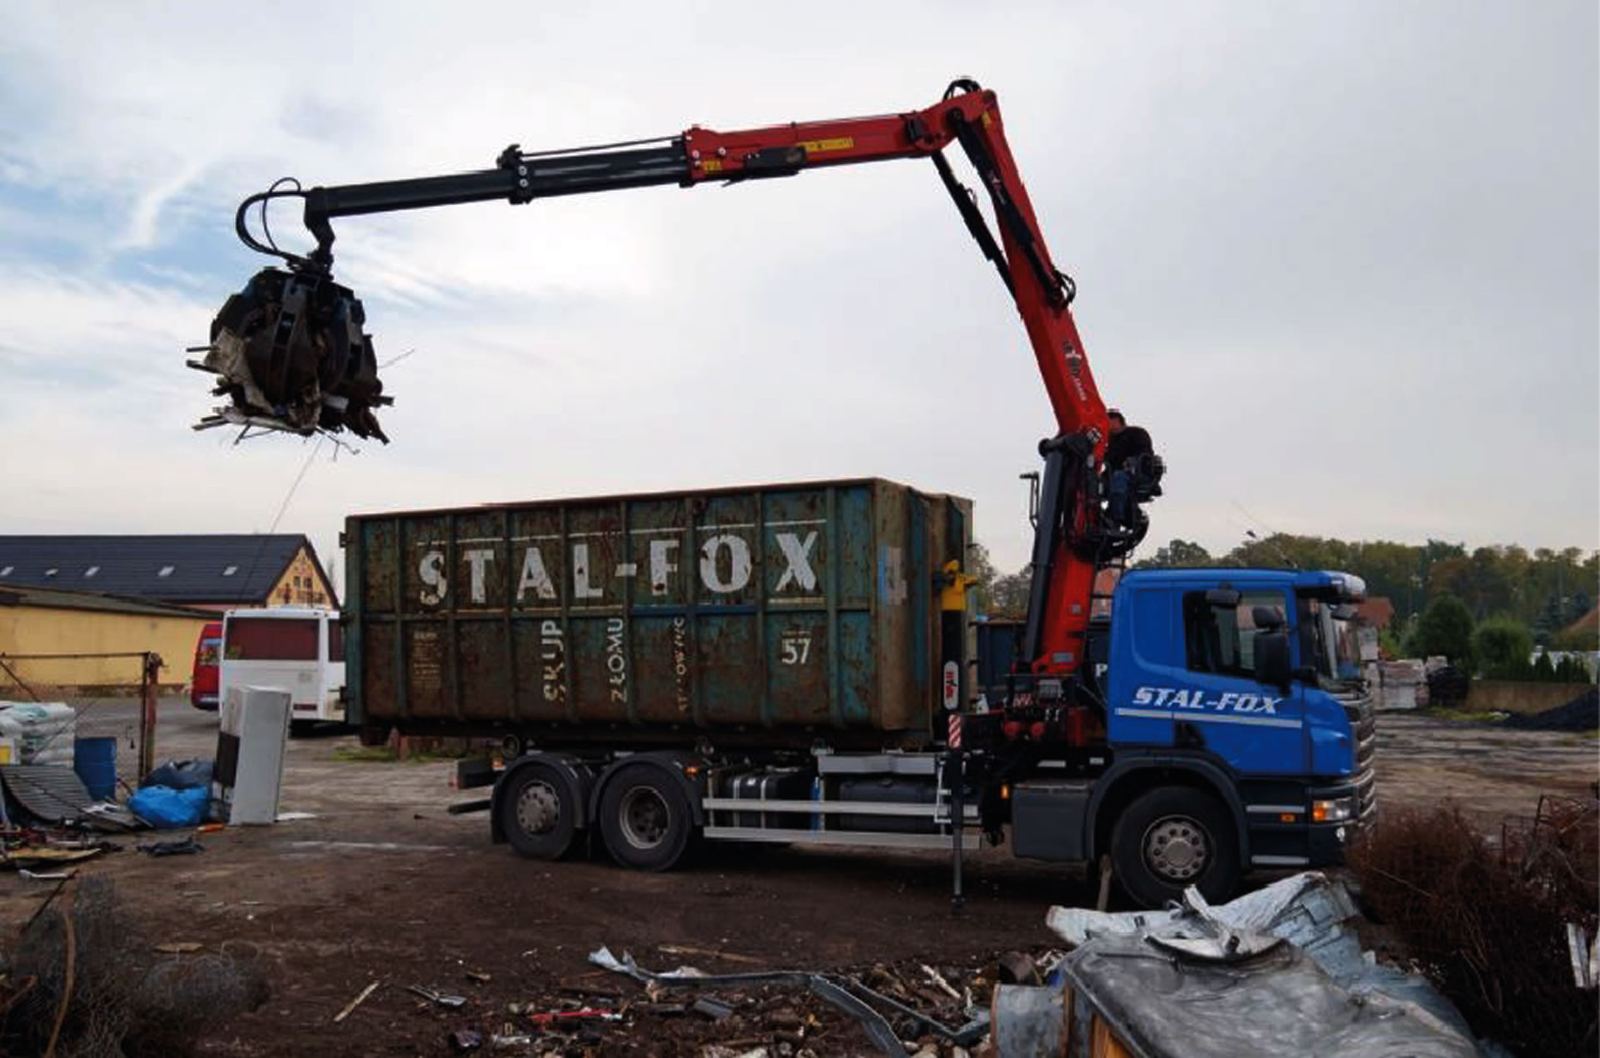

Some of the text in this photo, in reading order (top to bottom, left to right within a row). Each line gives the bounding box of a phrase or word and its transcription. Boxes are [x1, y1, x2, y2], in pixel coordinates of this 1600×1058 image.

[418, 530, 819, 606] STAL-FOX
[541, 620, 566, 702] SKUP
[781, 638, 812, 665] 57
[1132, 687, 1283, 714] STAL-FOX
